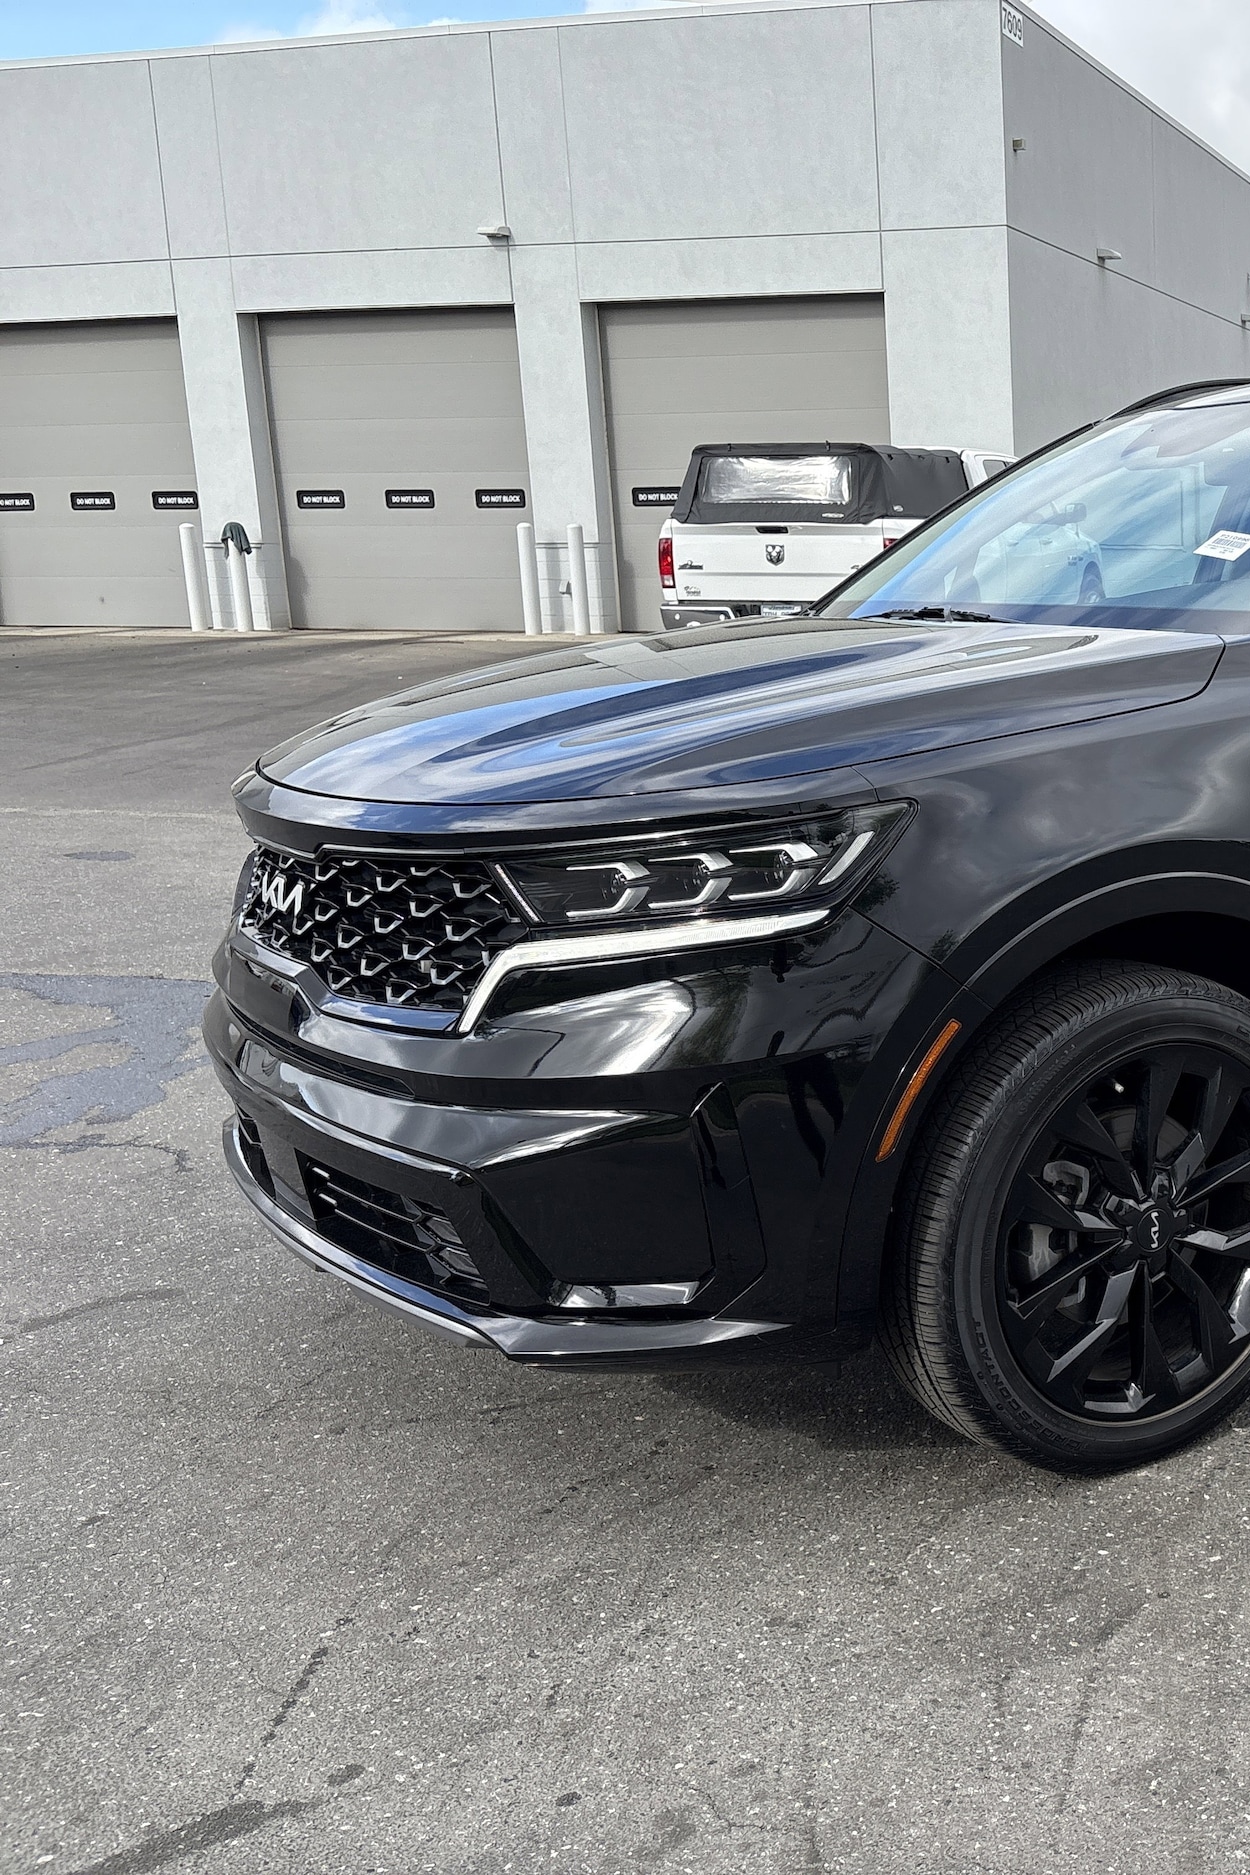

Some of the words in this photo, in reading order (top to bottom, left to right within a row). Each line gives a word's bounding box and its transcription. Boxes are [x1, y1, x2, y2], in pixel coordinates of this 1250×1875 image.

[1002, 7, 1022, 40] 7609
[638, 493, 647, 501] DO
[648, 493, 659, 501] NOT
[660, 493, 678, 501] BLOCK
[262, 871, 303, 916] KIA
